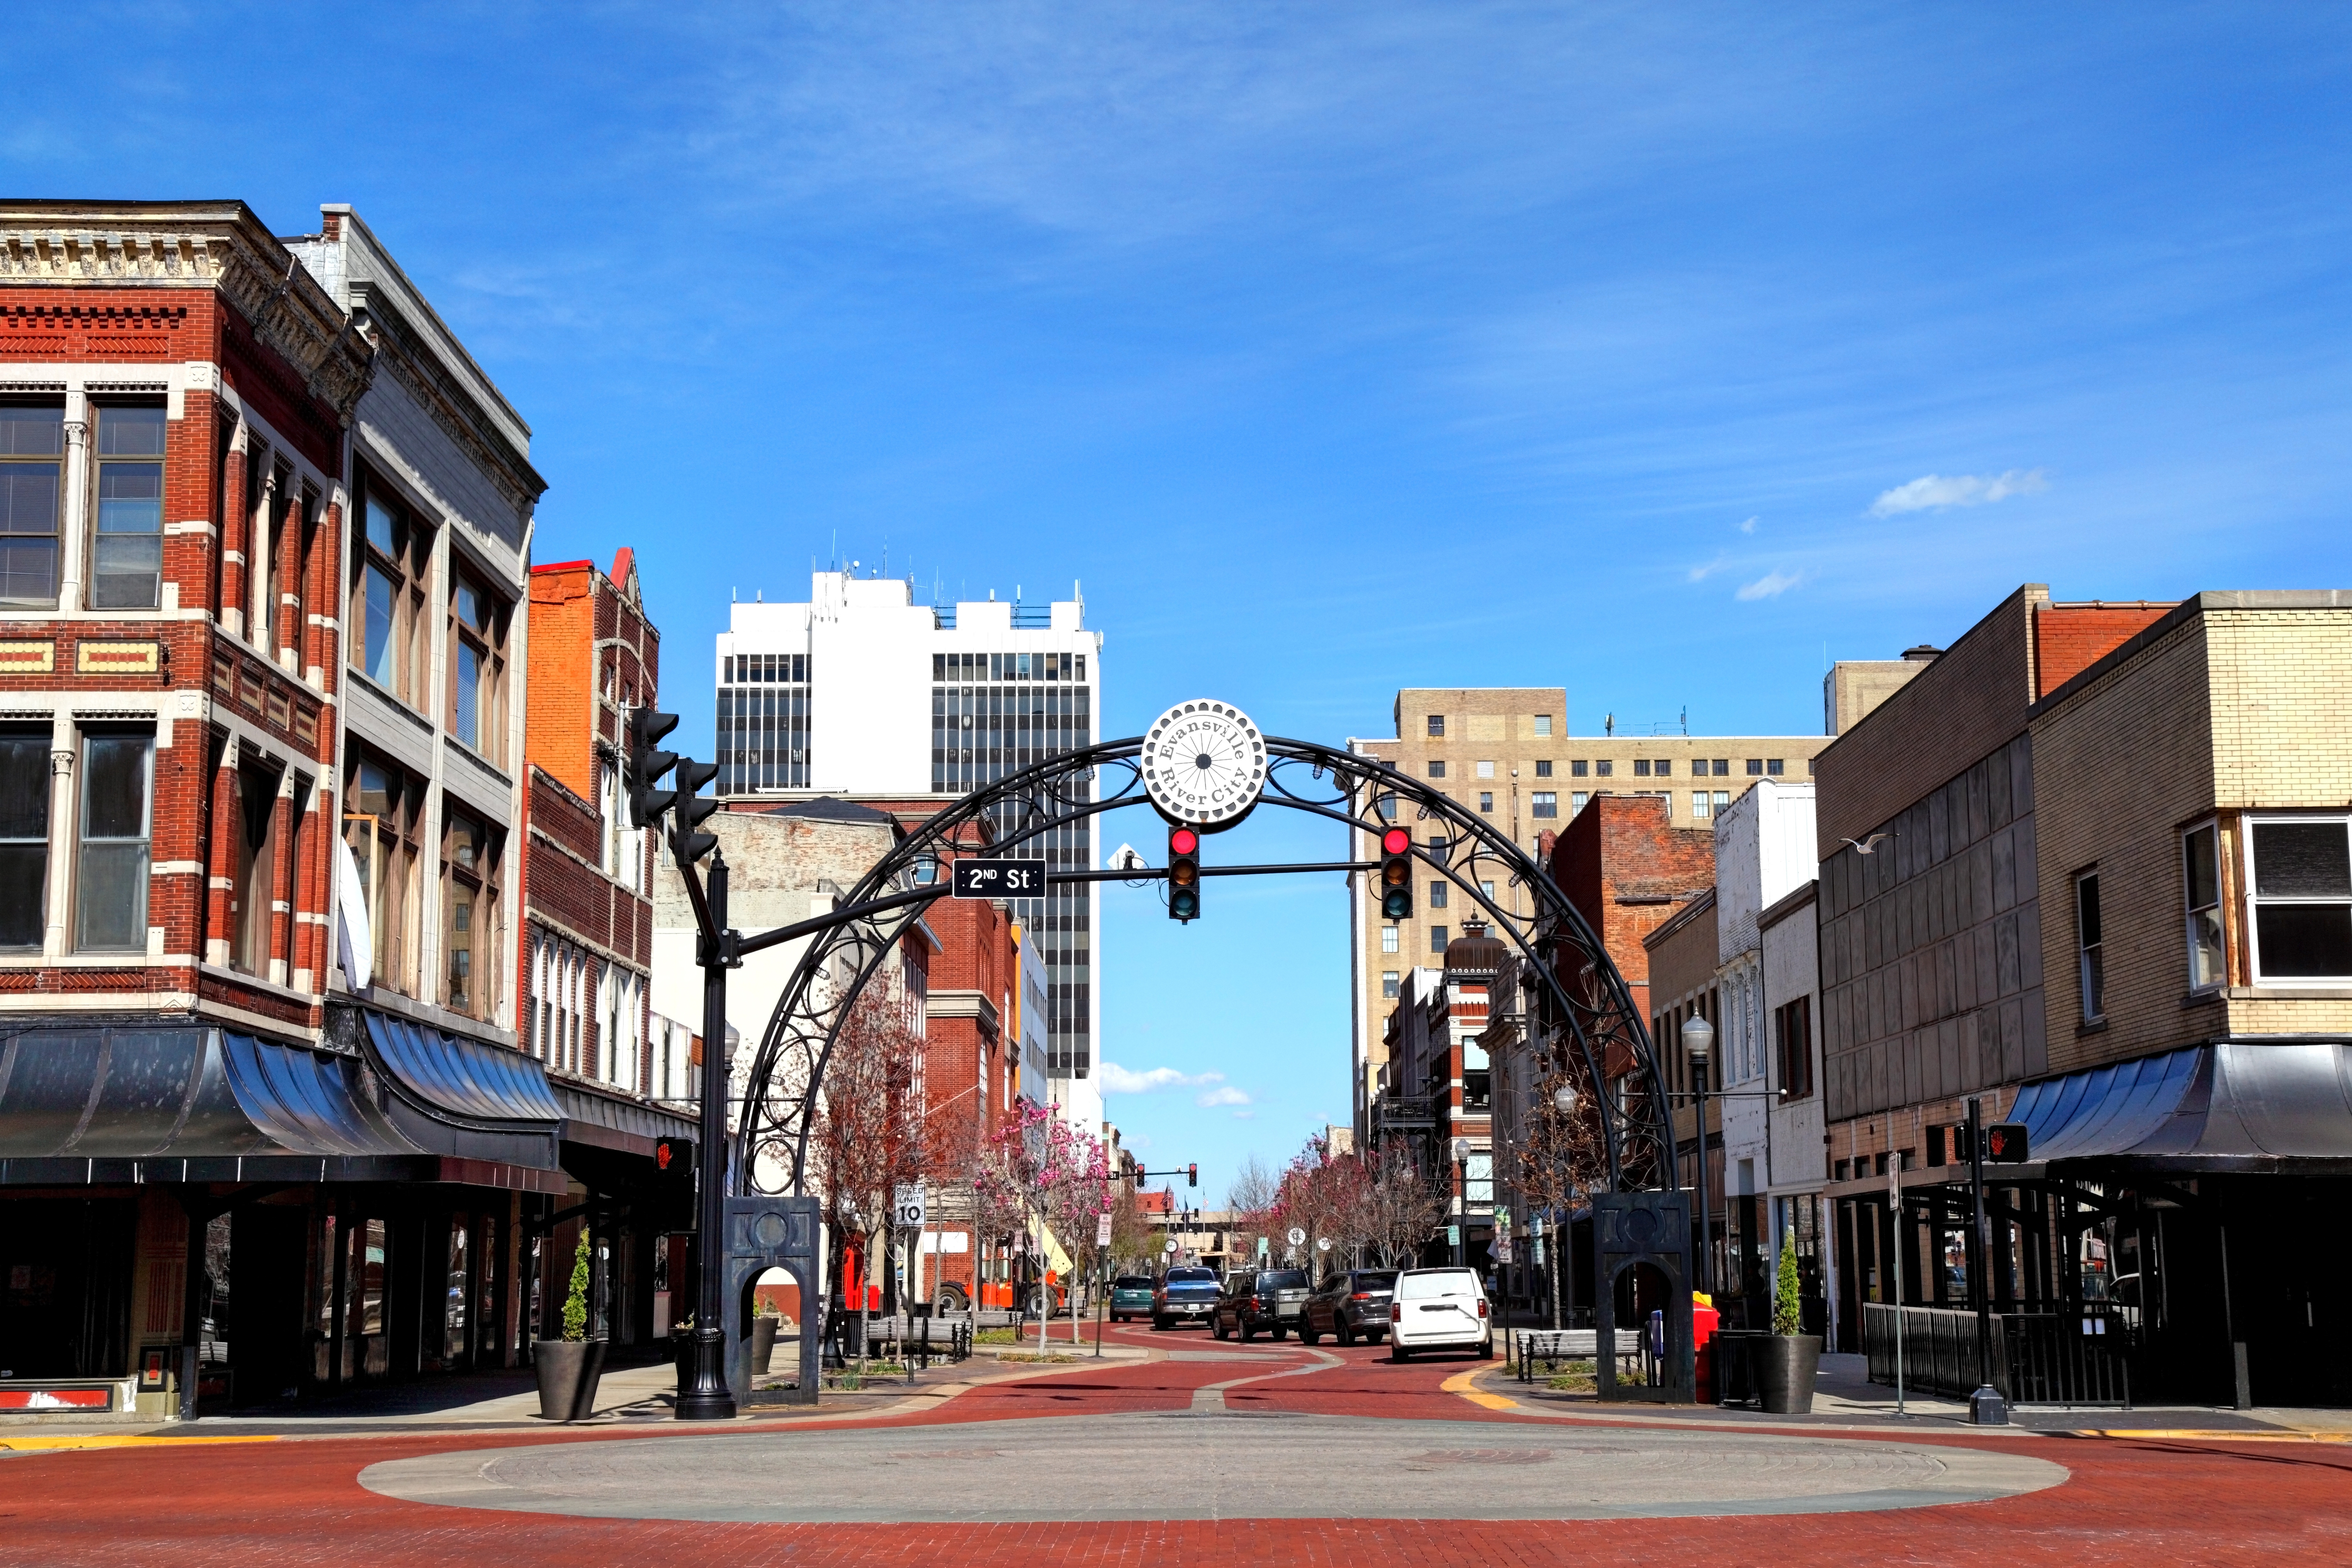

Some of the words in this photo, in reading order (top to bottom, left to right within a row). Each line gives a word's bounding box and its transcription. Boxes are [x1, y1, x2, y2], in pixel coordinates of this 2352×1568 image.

[1159, 721, 1244, 760] Evansville
[1160, 767, 1207, 805] River
[1211, 767, 1248, 803] City
[1006, 869, 1030, 889] St
[900, 1206, 920, 1221] 10
